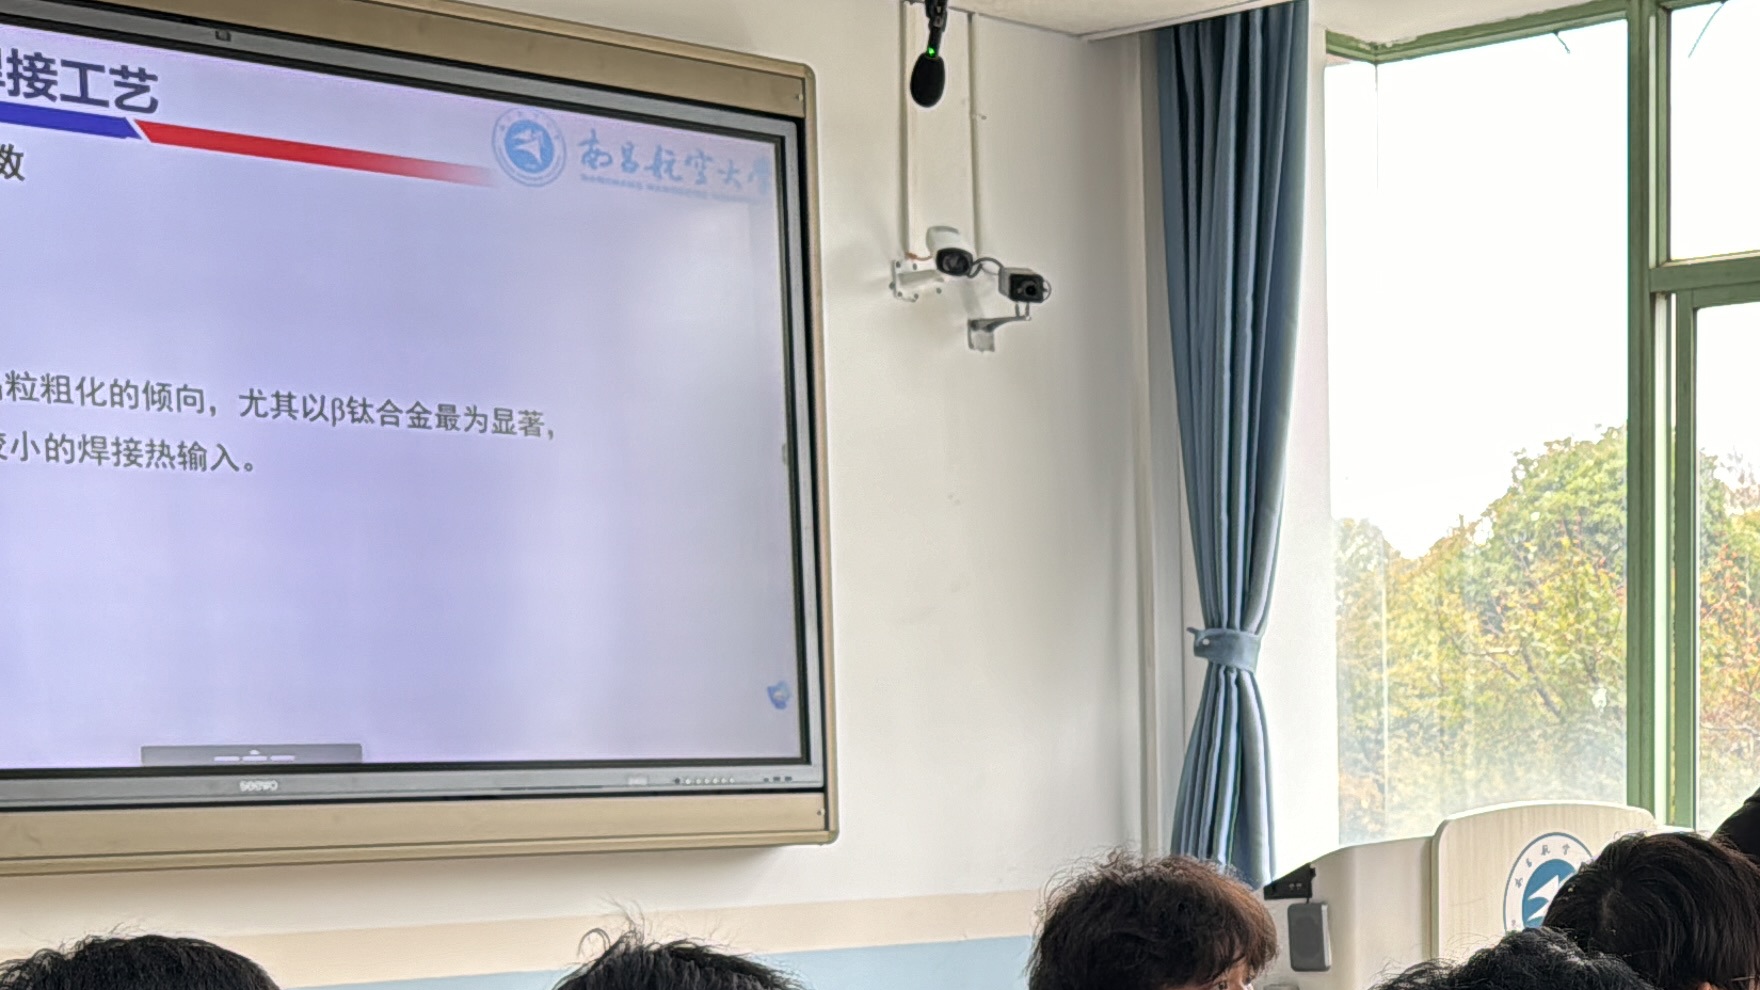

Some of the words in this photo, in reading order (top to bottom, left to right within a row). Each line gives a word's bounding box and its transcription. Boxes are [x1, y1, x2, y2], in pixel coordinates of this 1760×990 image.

[0, 47, 158, 114] 接工艺
[0, 369, 555, 441] 粒粗化的倾向，尤其以β钛合金最为显著，
[0, 430, 254, 472] 小的焊接热输入。
